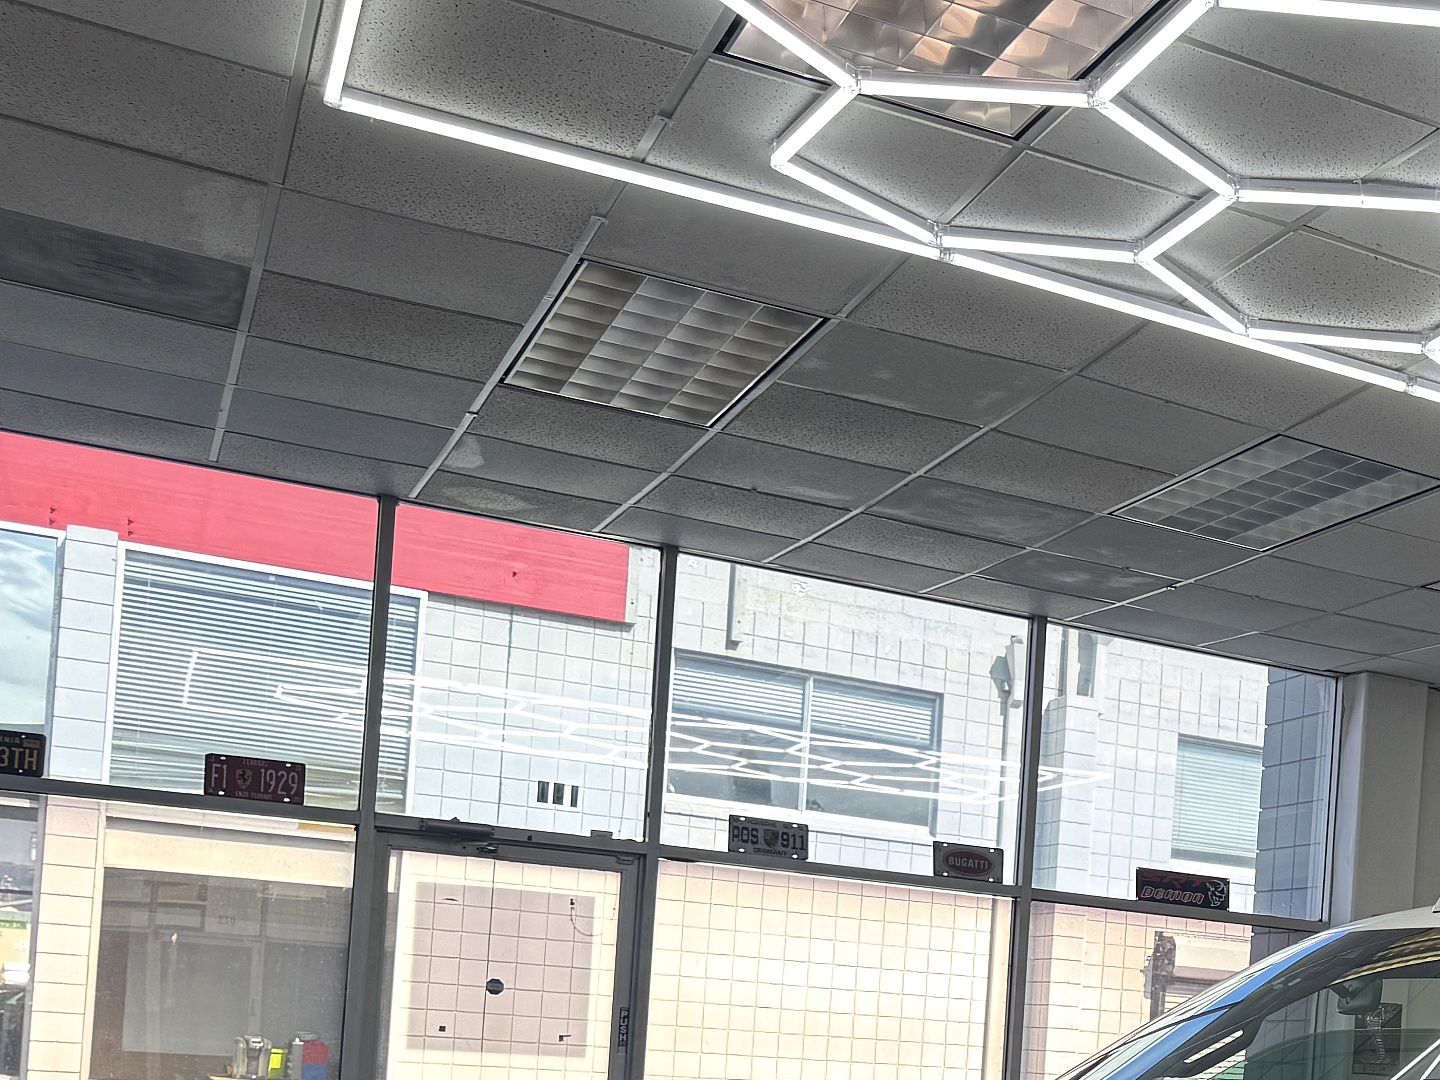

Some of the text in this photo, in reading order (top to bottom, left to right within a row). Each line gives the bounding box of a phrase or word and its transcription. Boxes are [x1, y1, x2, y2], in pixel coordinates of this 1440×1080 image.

[211, 763, 299, 796] F1 1929
[781, 831, 807, 851] 911
[948, 856, 988, 870] BUGATTI
[619, 1010, 629, 1042] PUSH
